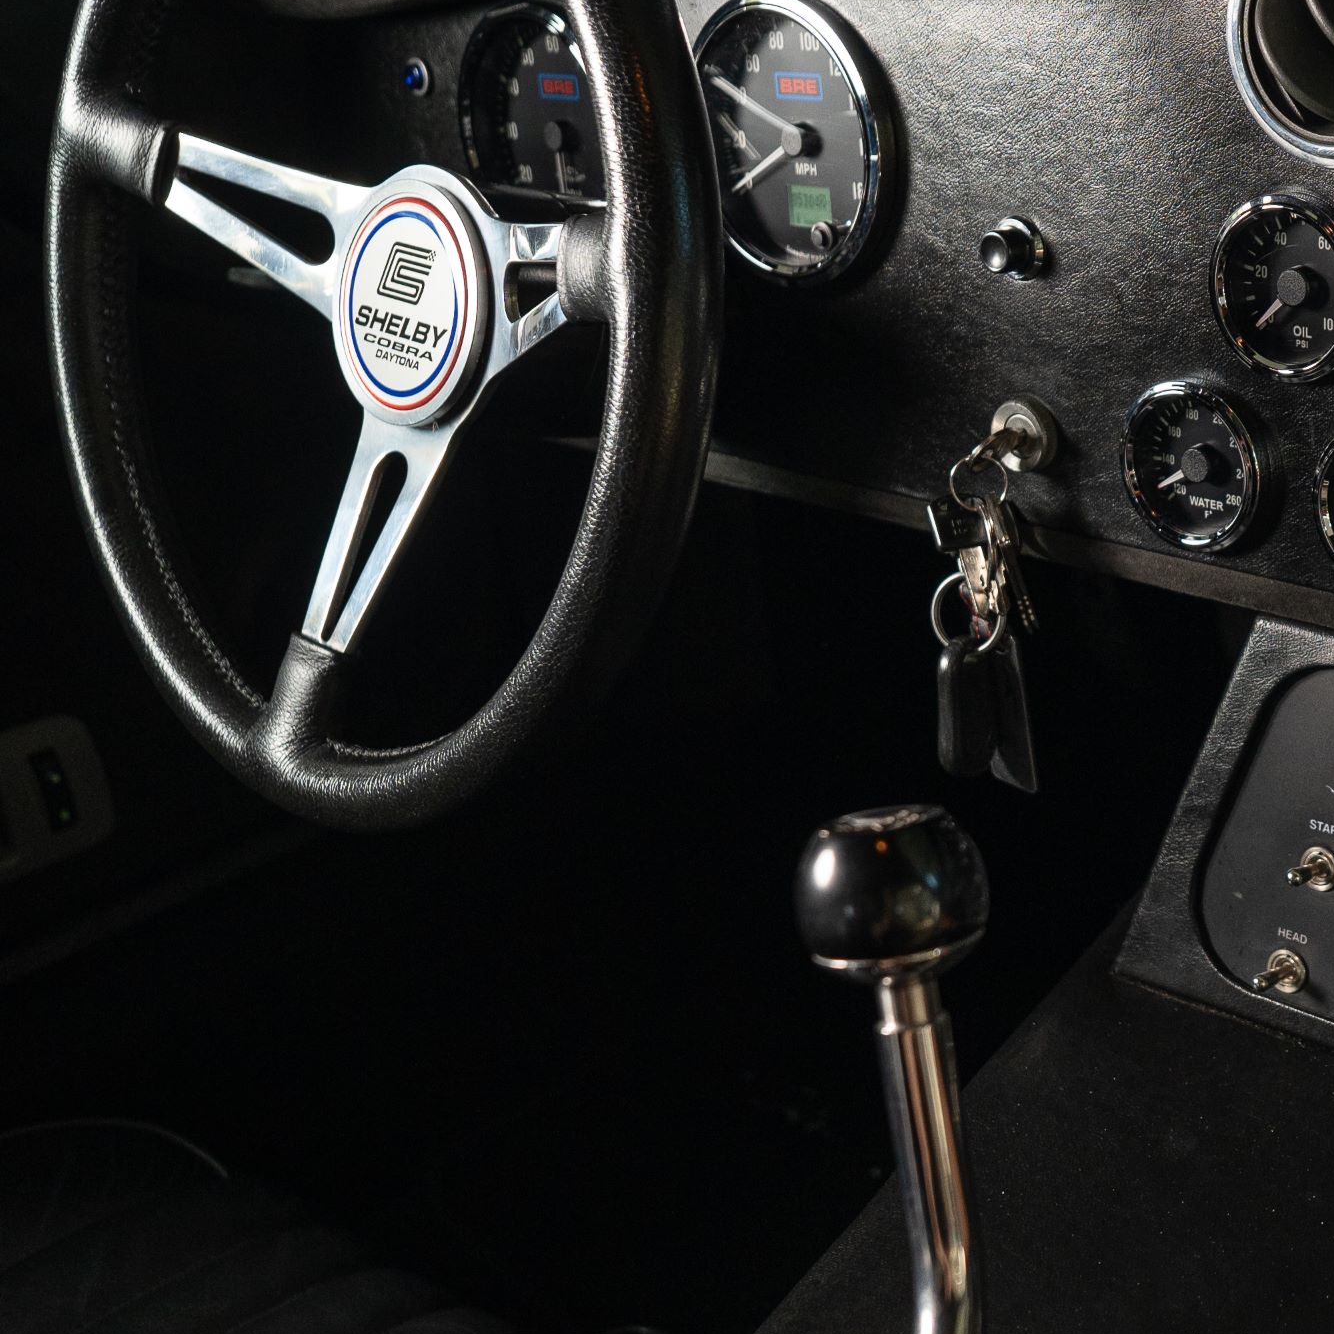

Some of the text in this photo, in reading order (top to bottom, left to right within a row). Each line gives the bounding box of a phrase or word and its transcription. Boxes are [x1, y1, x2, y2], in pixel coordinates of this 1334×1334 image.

[769, 31, 784, 50] 80
[778, 76, 819, 96] BRE
[795, 161, 819, 177] MPH
[1274, 231, 1287, 246] 40
[1255, 265, 1268, 279] 20
[354, 305, 448, 348] SHELBY
[1293, 325, 1313, 339] OIL
[363, 333, 433, 362] COBRA
[1295, 338, 1309, 349] PSI
[375, 349, 420, 371] DAYTONA
[1185, 408, 1199, 421] 180
[1168, 425, 1182, 438] 160
[1162, 453, 1175, 465] 140
[1173, 483, 1187, 496] 120
[1189, 494, 1224, 512] WATER
[1225, 493, 1242, 507] 260
[1277, 926, 1308, 945] HEAD
